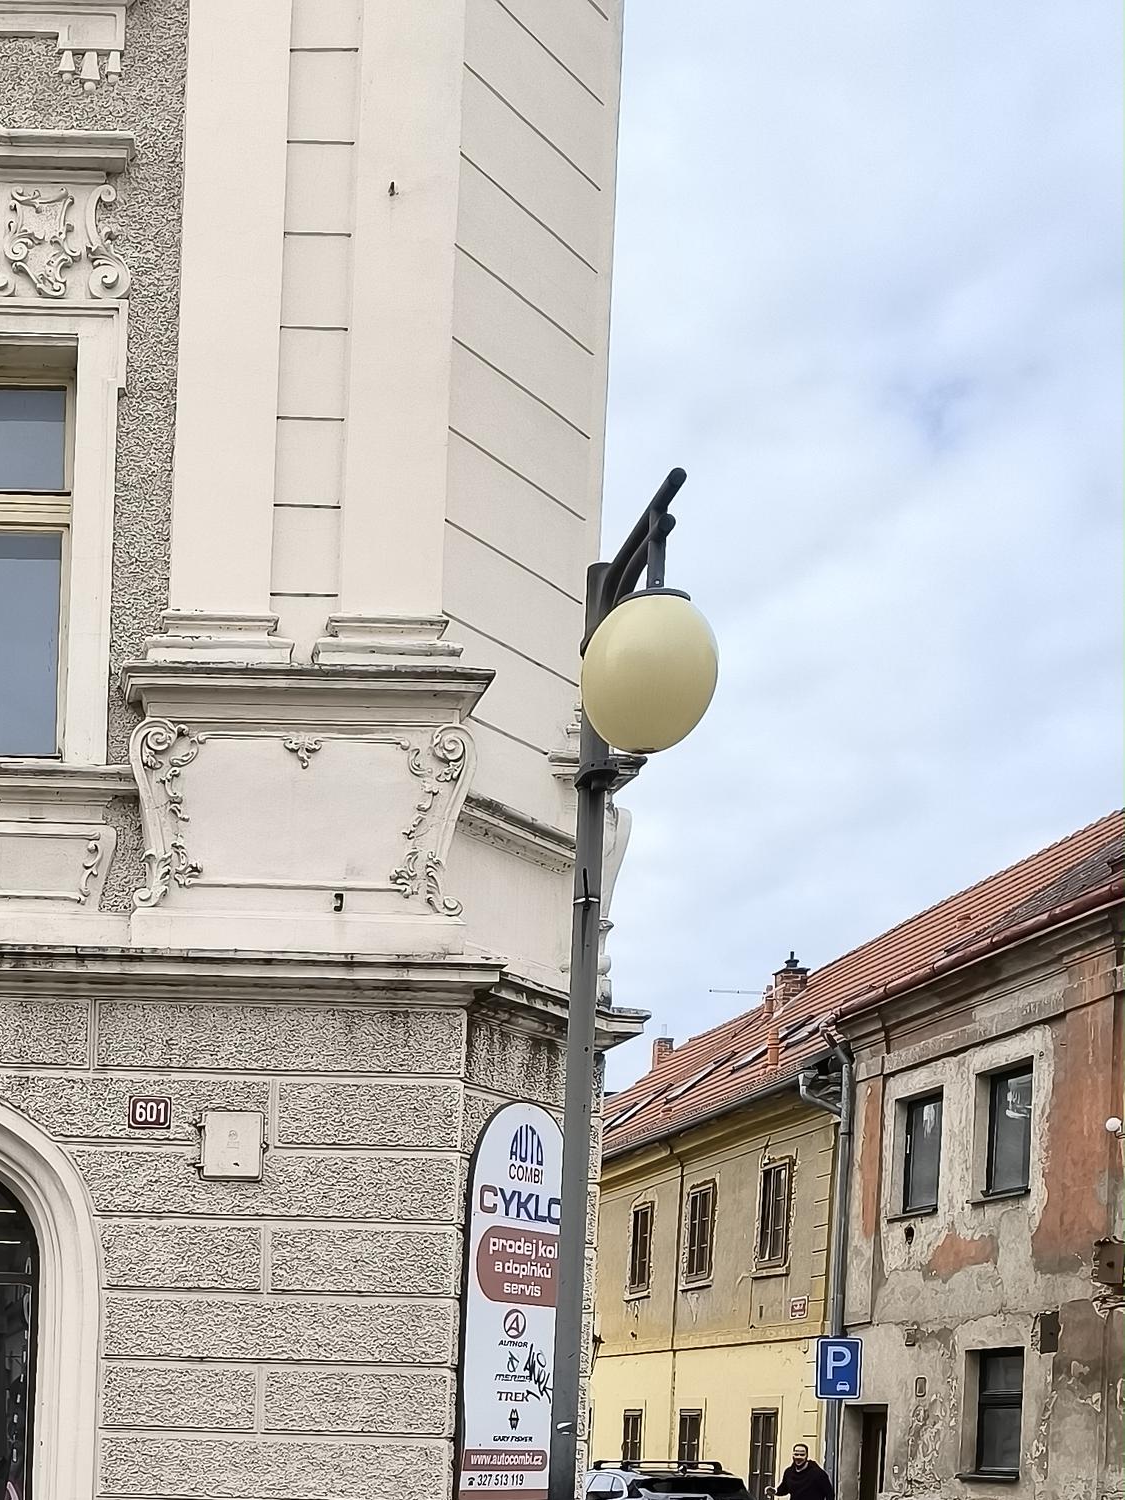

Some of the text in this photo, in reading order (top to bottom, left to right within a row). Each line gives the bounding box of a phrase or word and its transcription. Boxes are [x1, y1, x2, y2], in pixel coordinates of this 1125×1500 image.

[135, 1101, 166, 1123] 601
[509, 1124, 544, 1167] AUTO
[508, 1163, 544, 1185] COMBI
[489, 1237, 558, 1260] prodej kol
[494, 1261, 503, 1273] a
[503, 1281, 542, 1297] servis
[498, 1339, 528, 1348] AUTHOR
[826, 1345, 852, 1380] P
[496, 1390, 529, 1402] TREK
[470, 1452, 543, 1466] www.autocombi.cz
[477, 1473, 525, 1487] 327 513 119
